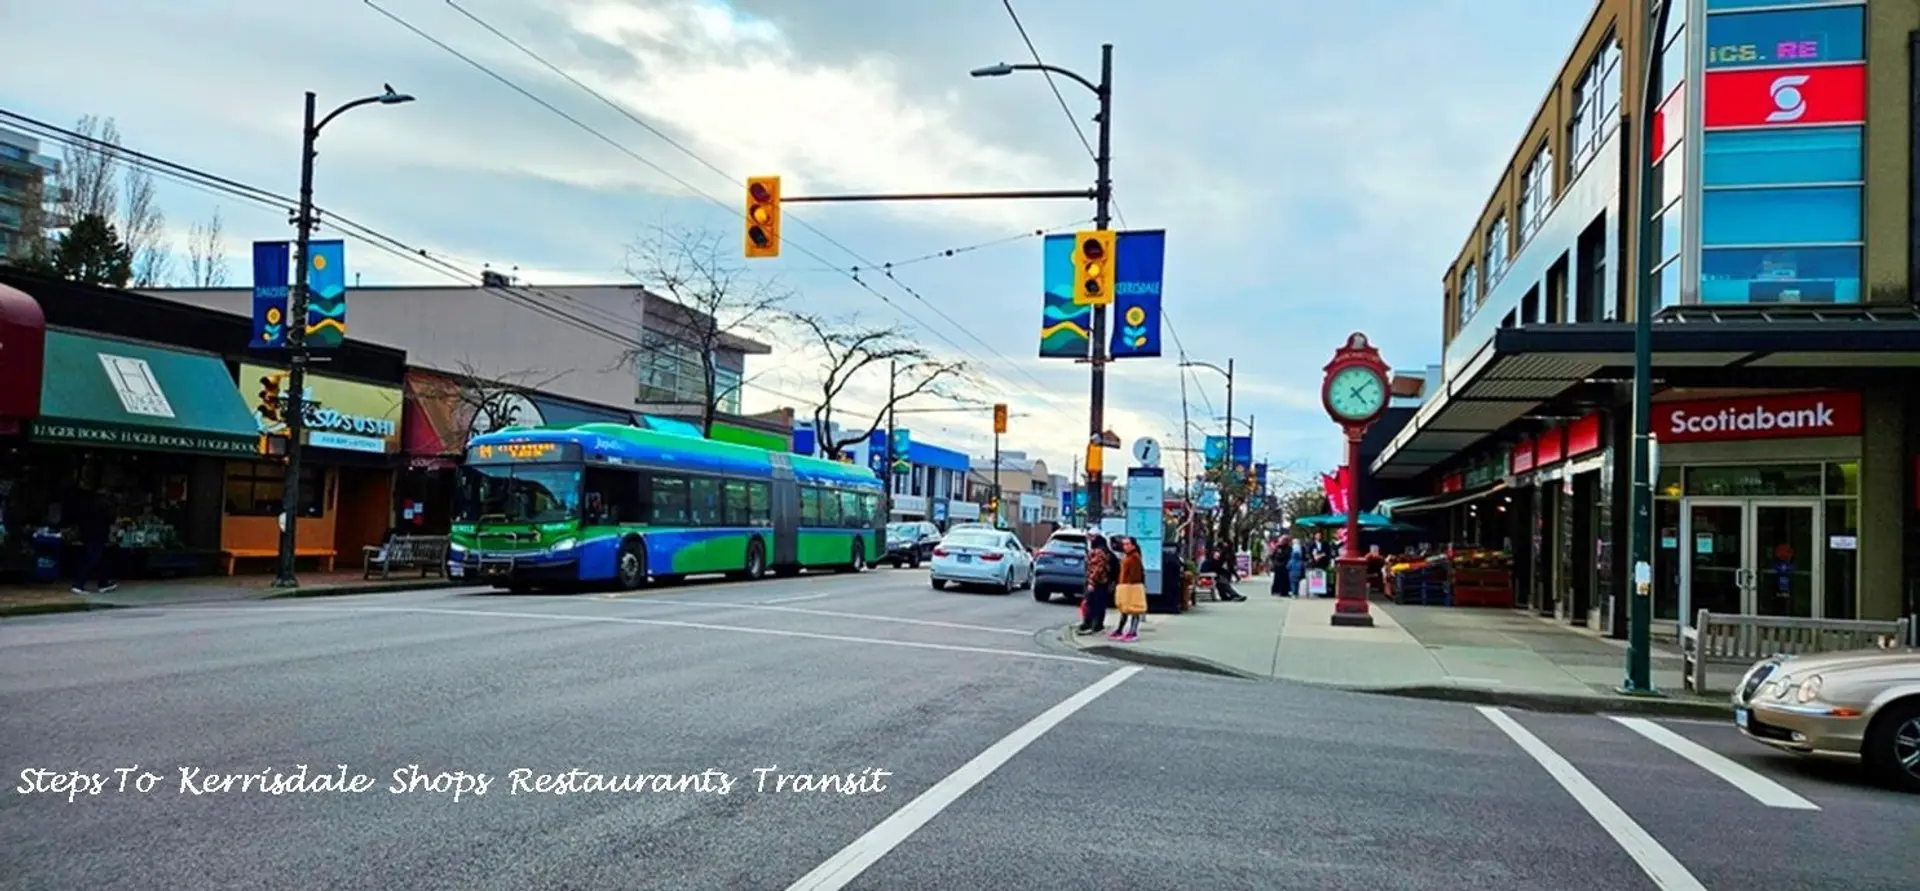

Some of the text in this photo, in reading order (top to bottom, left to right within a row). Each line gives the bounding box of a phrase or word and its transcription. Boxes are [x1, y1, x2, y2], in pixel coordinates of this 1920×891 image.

[1671, 402, 1834, 433] Scotiabank
[34, 424, 75, 438] HAGER
[78, 427, 117, 441] BOOKS
[121, 431, 158, 444] HAGER
[159, 435, 195, 448] BOOKS
[197, 437, 229, 450] HAGER
